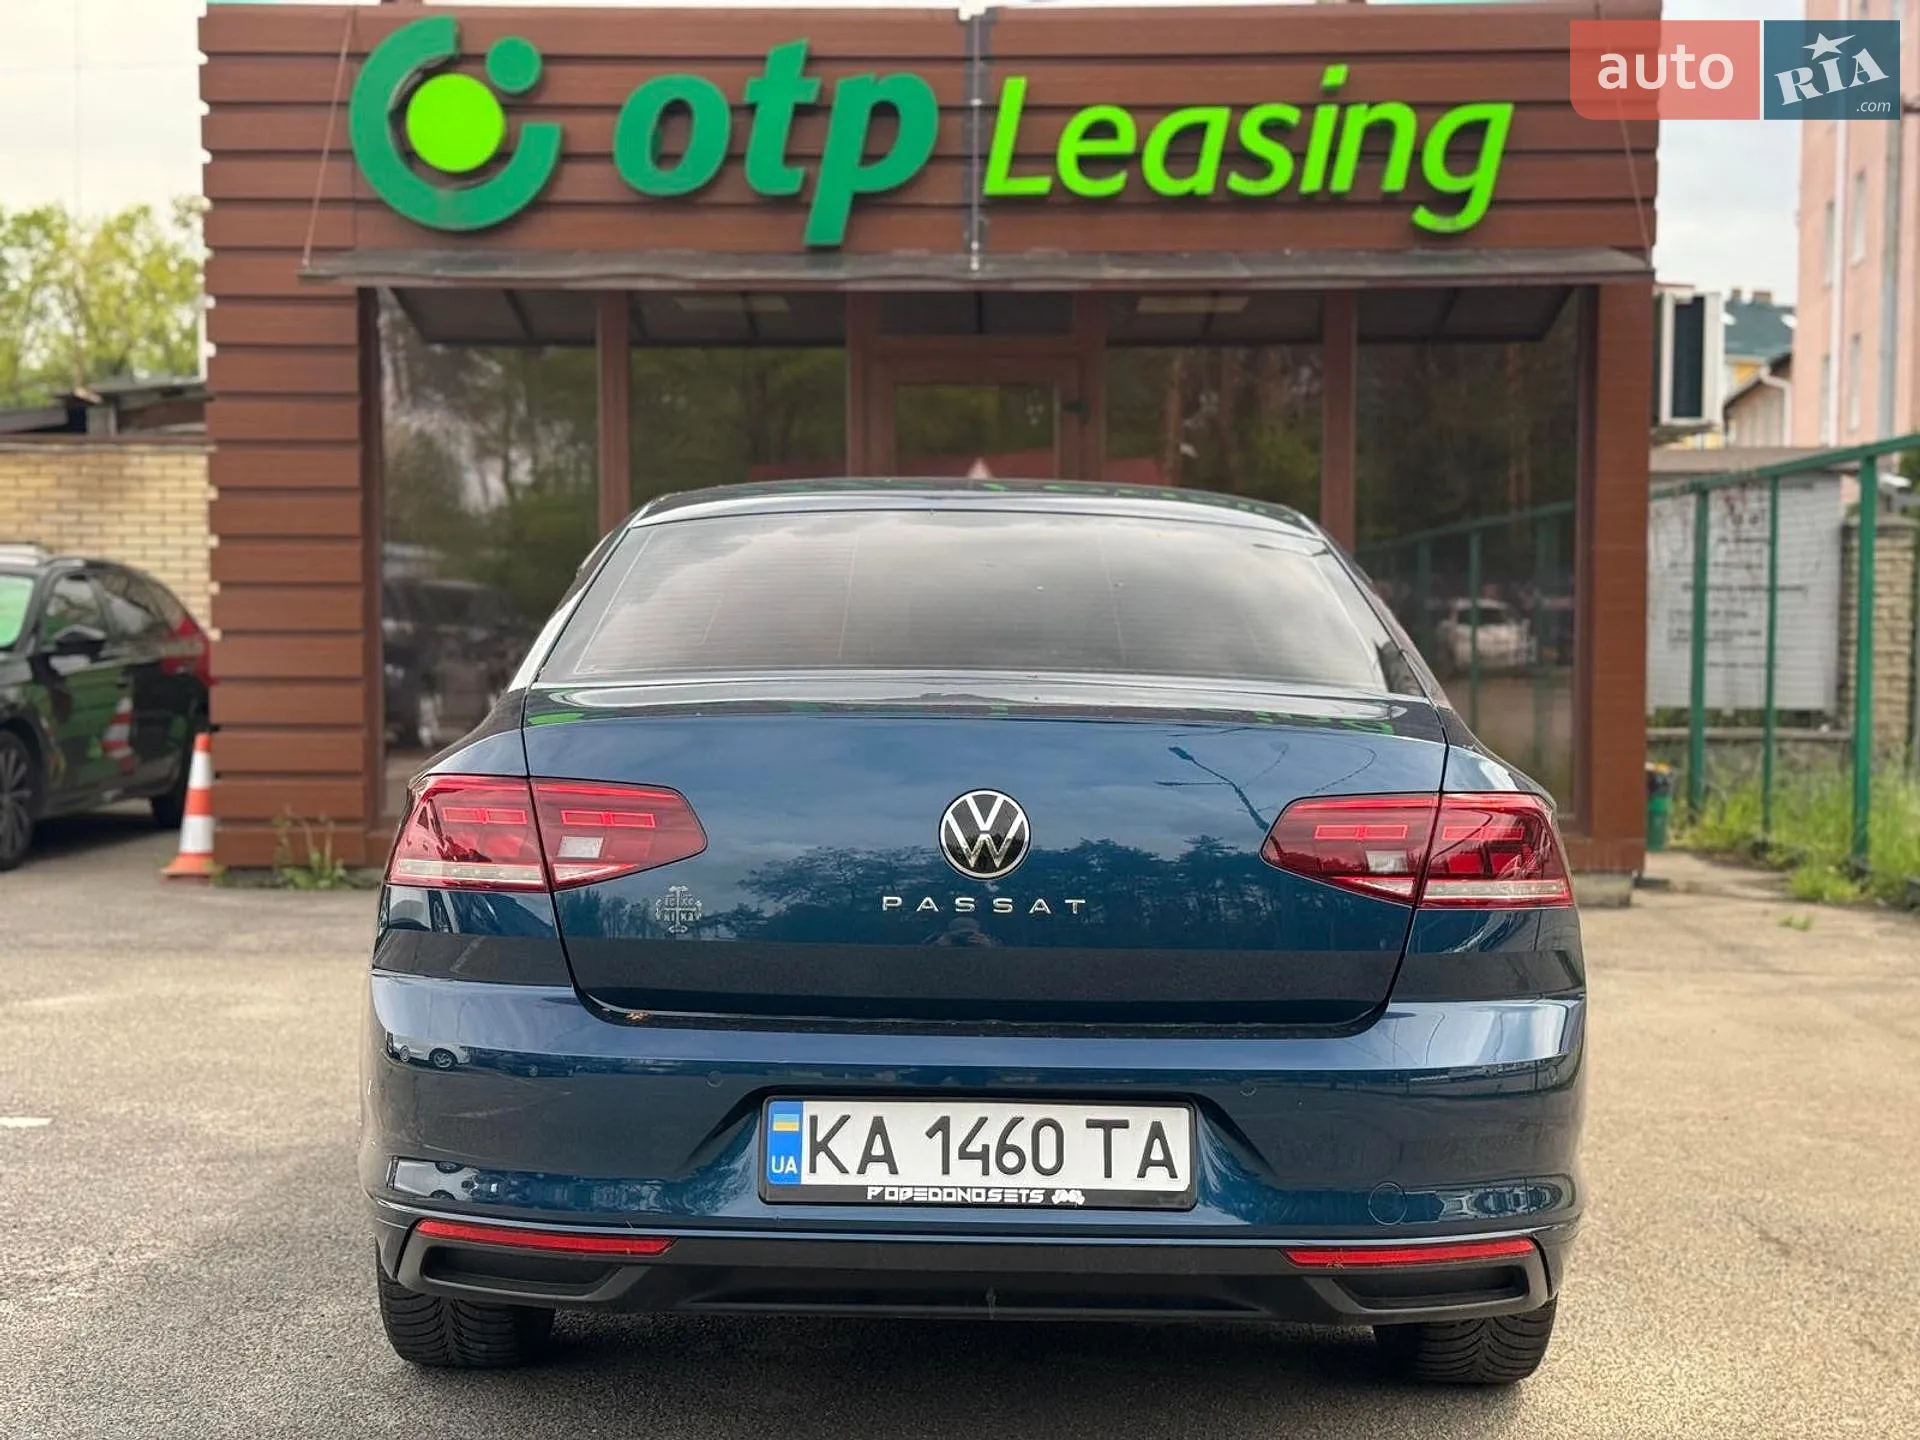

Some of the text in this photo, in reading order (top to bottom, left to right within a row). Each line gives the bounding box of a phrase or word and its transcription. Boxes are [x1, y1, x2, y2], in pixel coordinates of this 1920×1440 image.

[613, 38, 1514, 247] otp Leasing
[882, 896, 1087, 915] PASSAT
[808, 1114, 1179, 1180] KA 1460 TA
[771, 1155, 798, 1174] UA
[866, 1186, 1046, 1203] POBEDONOSETS
